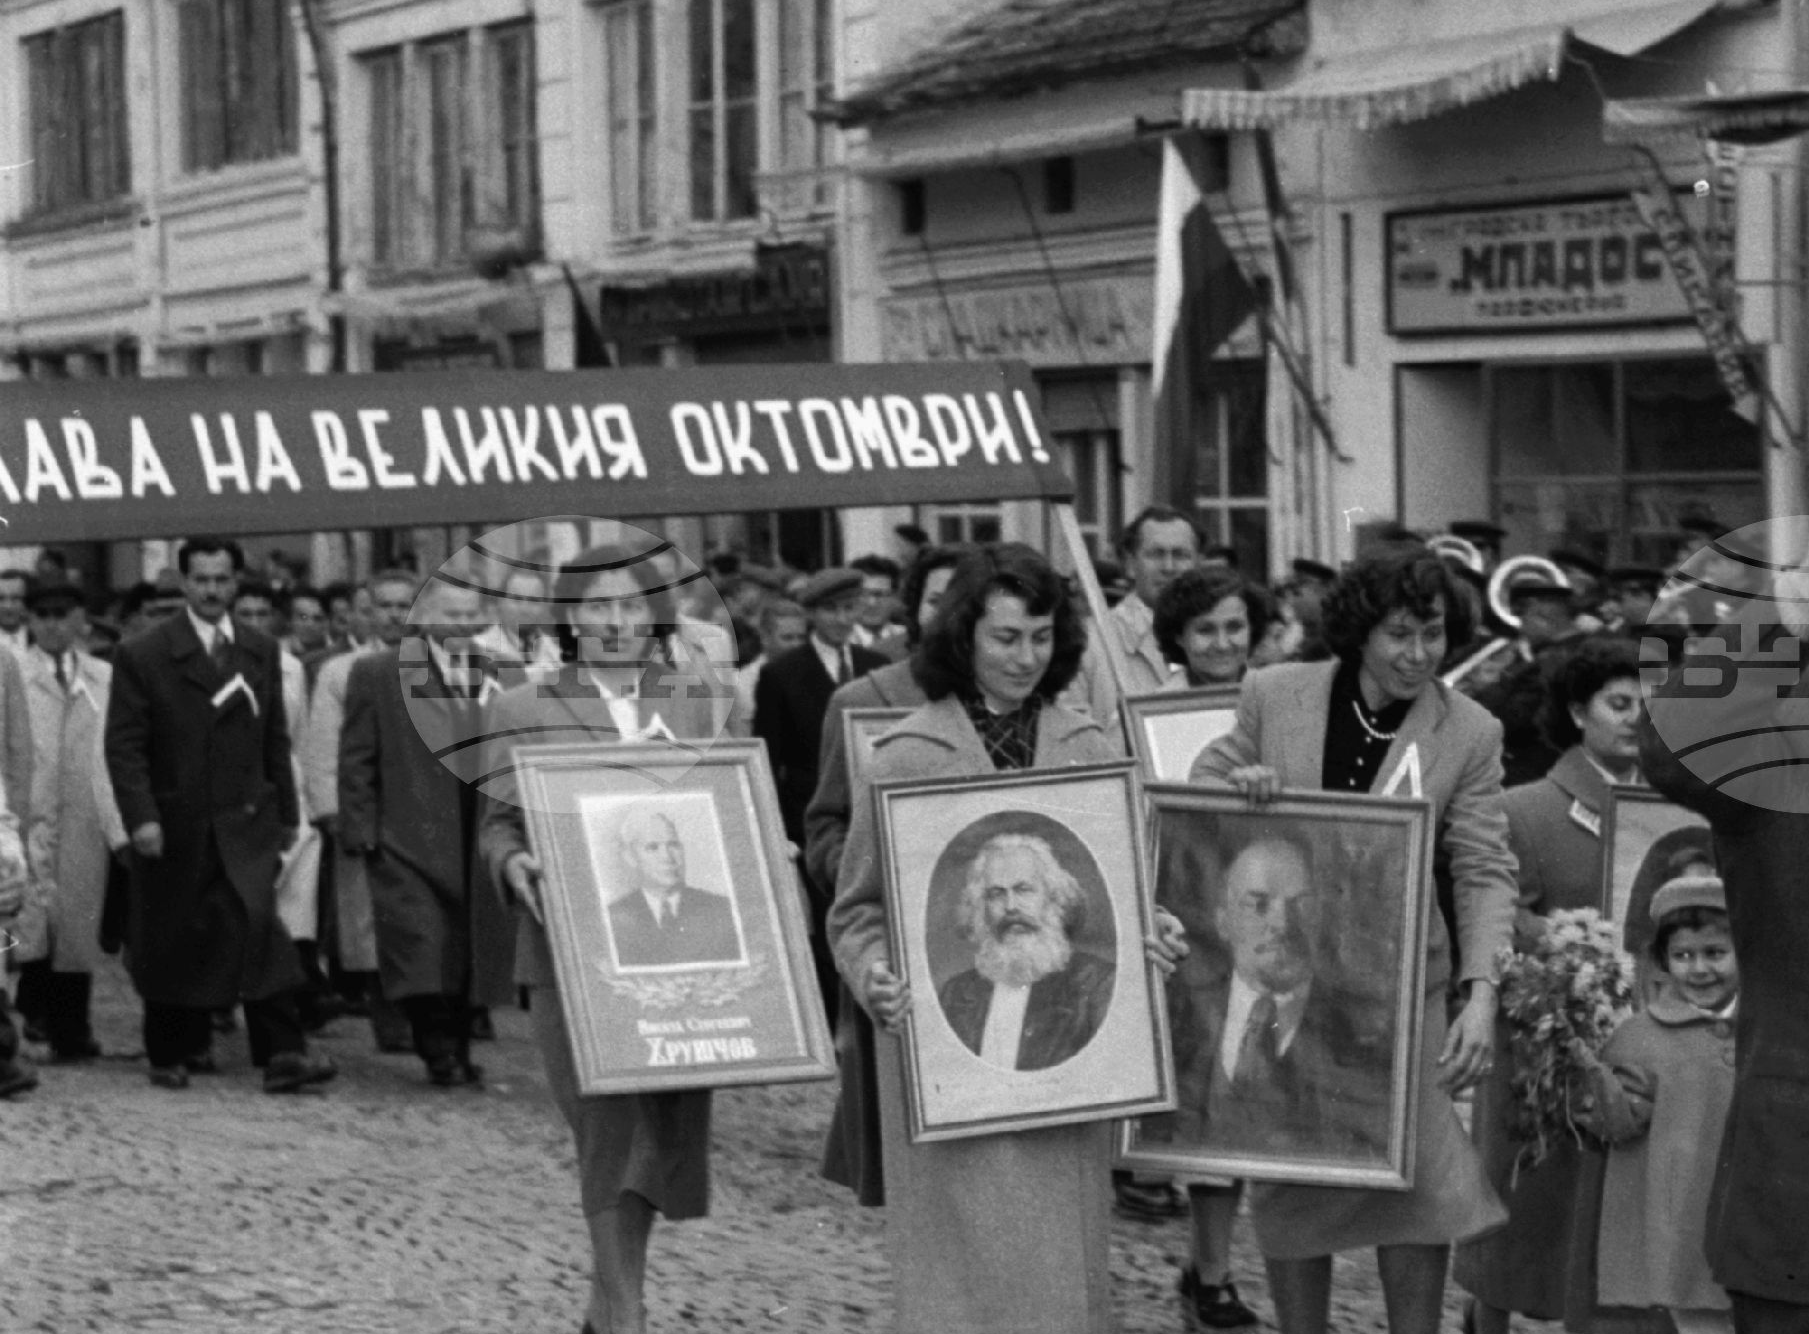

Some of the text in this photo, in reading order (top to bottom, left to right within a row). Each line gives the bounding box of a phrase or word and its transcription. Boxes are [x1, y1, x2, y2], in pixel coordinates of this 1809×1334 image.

[191, 411, 301, 494] НА
[311, 404, 648, 490] ВЕЛИКИЯ
[670, 390, 1050, 476] ОКТОМВРИ!
